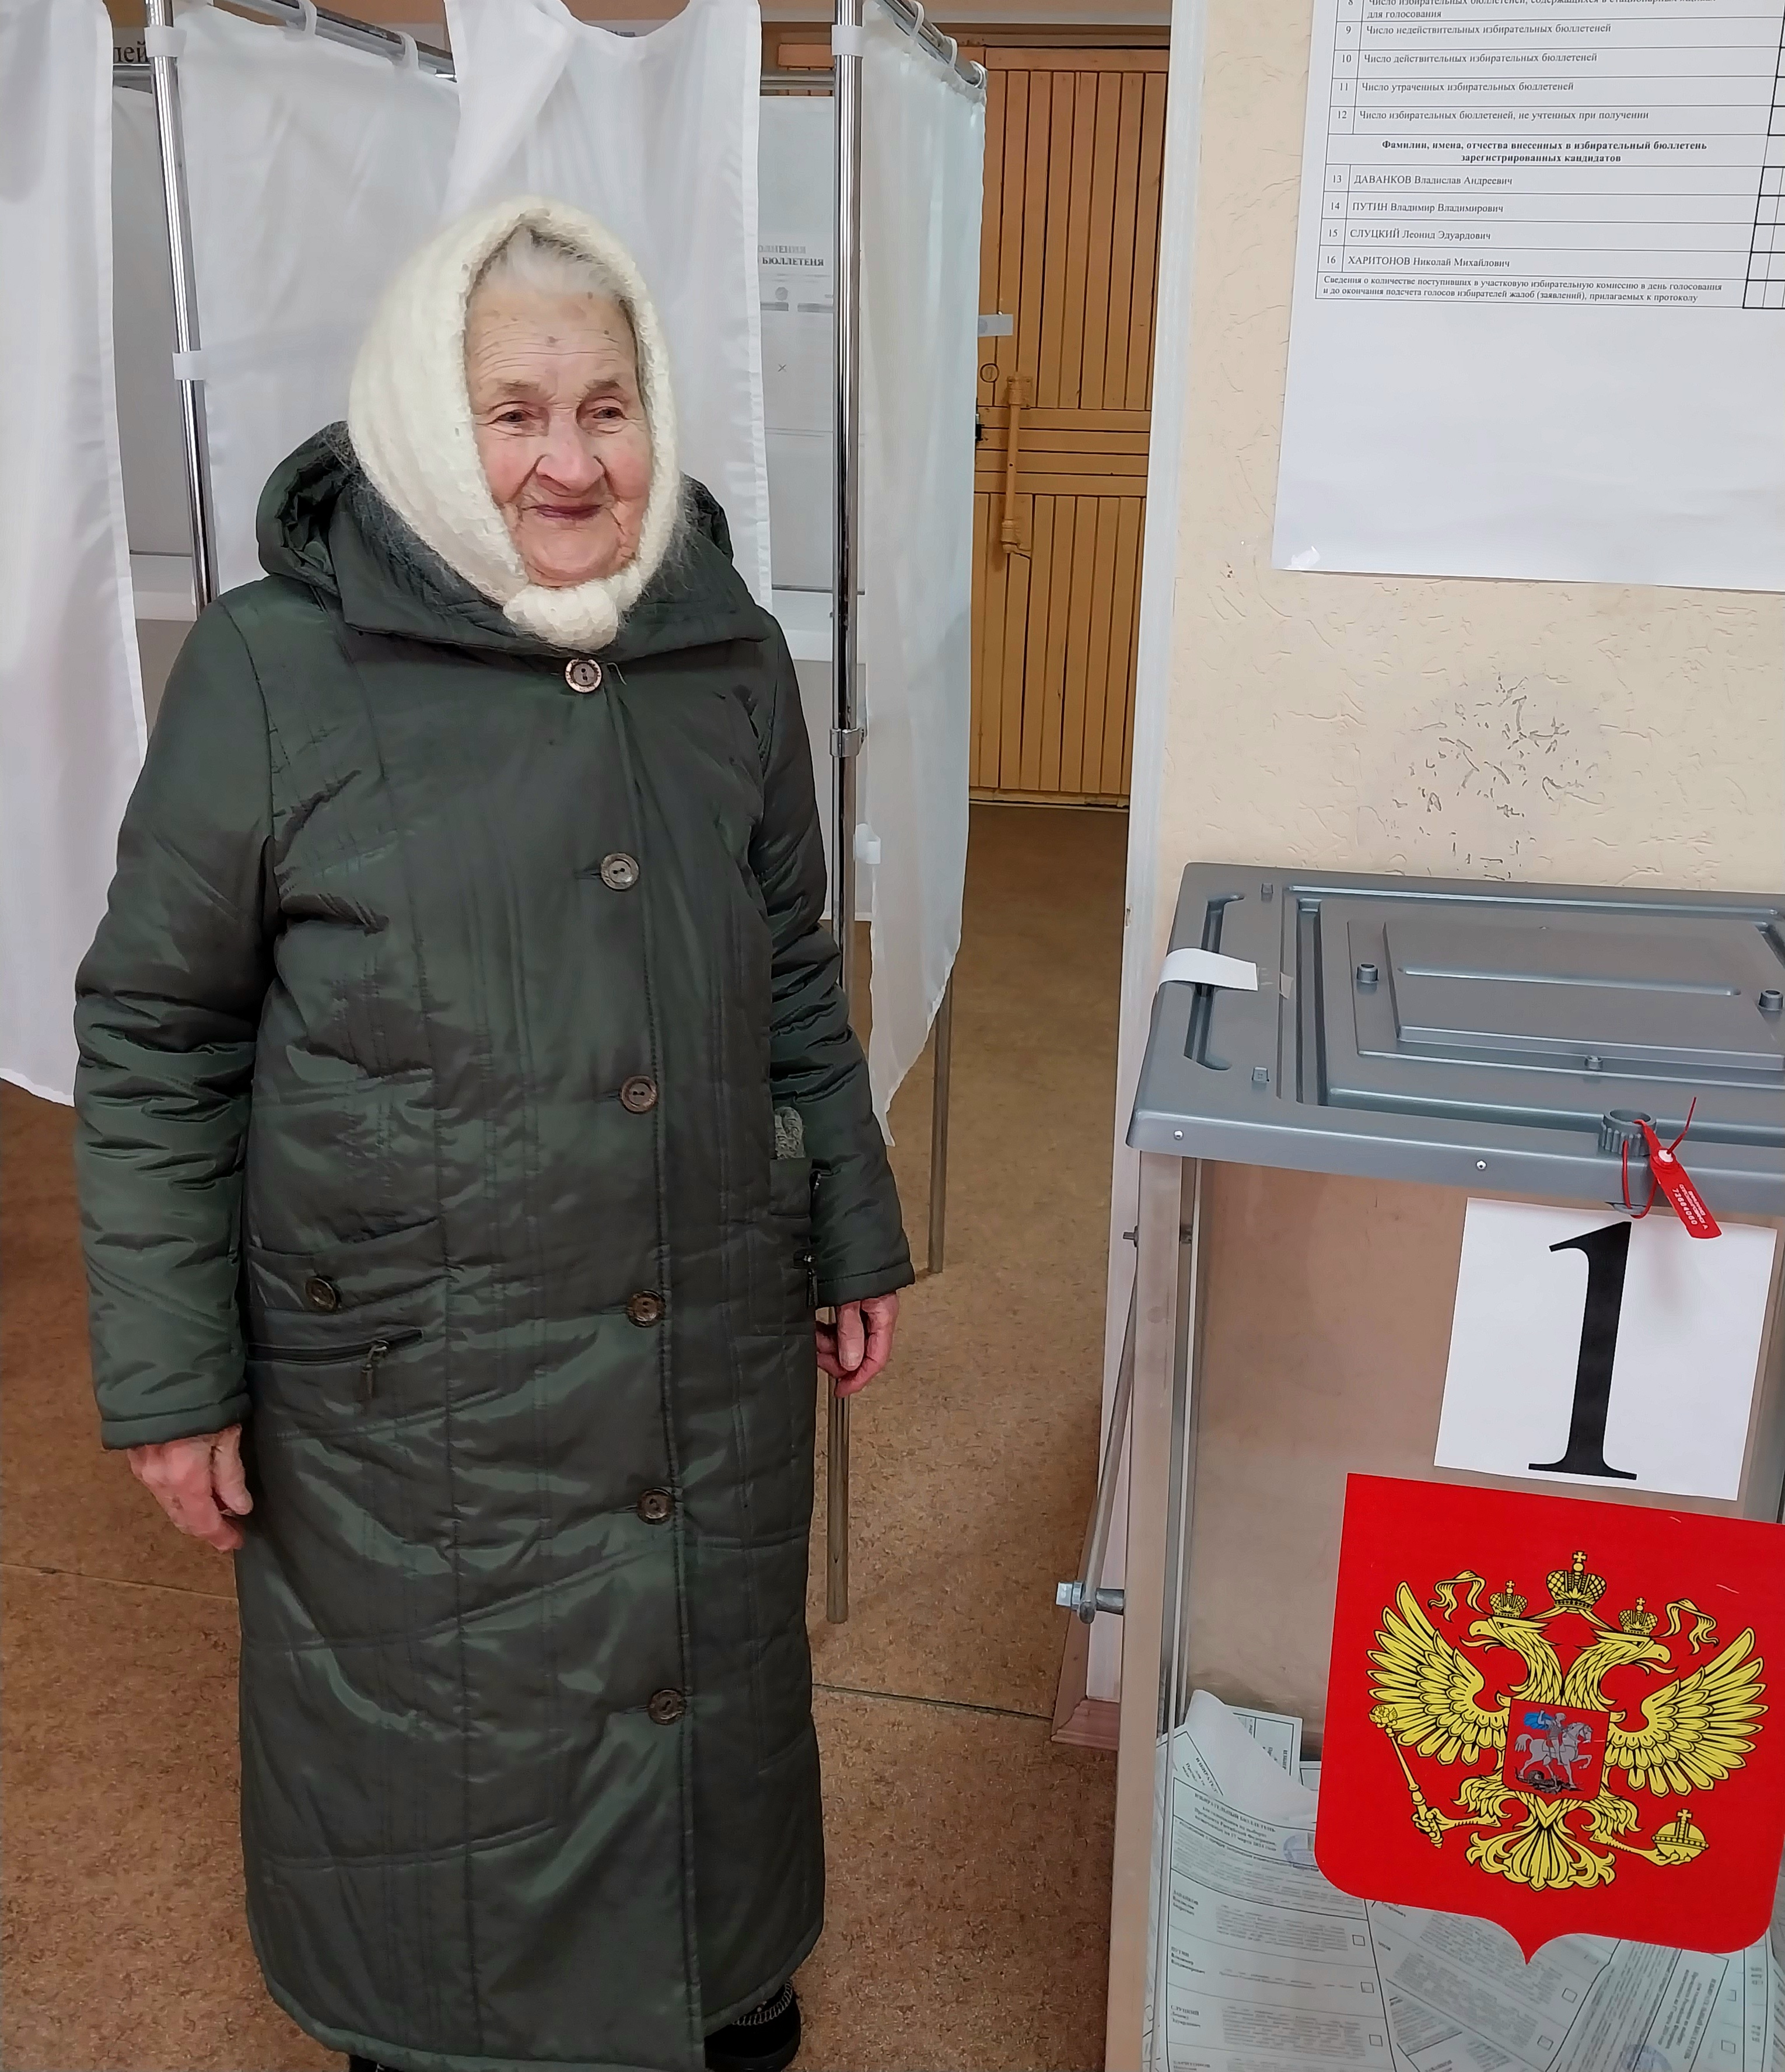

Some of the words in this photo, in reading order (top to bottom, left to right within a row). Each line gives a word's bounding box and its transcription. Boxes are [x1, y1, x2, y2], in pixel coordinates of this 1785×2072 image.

[1346, 25, 1352, 34] 9
[1366, 25, 1394, 34] Число
[1396, 25, 1480, 34] недействительных
[1482, 24, 1553, 36] избирательных
[1555, 23, 1611, 33] бюллетеней
[1342, 54, 1352, 63] 10
[1364, 54, 1392, 63] Число
[1393, 54, 1467, 64] действительных
[1469, 53, 1539, 65] избирательных
[1541, 52, 1597, 62] бюллетеней
[1340, 82, 1348, 91] 11
[1362, 82, 1389, 91] Число
[1391, 85, 1445, 93] утраченных
[1447, 82, 1516, 93] избирательных
[1518, 82, 1574, 91] бюллетеней
[1338, 110, 1347, 119] 12
[1360, 110, 1387, 119] Число
[1389, 110, 1457, 122] избирательных
[1459, 110, 1516, 121] бюллетеней,
[1531, 113, 1576, 121] учтенных
[1578, 113, 1596, 122] при
[1598, 112, 1649, 121] получении
[1382, 140, 1430, 150] Фамилии,
[1432, 142, 1464, 150] имена,
[1574, 141, 1651, 152] избирательный
[1653, 141, 1707, 150] бюллетень
[1461, 155, 1562, 164] зарегистрированных
[1333, 174, 1342, 183] 13
[1353, 174, 1412, 185] ДАВАНКОВ
[1414, 175, 1461, 185] Владислав
[1464, 176, 1513, 187] Андреевич
[1331, 201, 1340, 211] 14
[1352, 202, 1388, 211] ПУТИН
[1390, 202, 1436, 214] Владимир
[1437, 203, 1504, 215] Владимирович
[1329, 229, 1338, 237] 15
[1350, 228, 1400, 239] СЛУЦКИЙ
[1401, 230, 1436, 239] Леонид
[1438, 230, 1491, 242] Эдуардович
[1327, 256, 1336, 264] 16
[1348, 256, 1410, 265] ХАРИТОНОВ
[1413, 257, 1451, 266] Николай
[1454, 258, 1510, 267] Михайлович
[1324, 275, 1362, 284] Сведения
[1418, 279, 1472, 287] поступивших
[1480, 280, 1529, 289] участковую
[1531, 279, 1594, 290] избирательную
[1457, 289, 1507, 299] избирателей
[1509, 290, 1535, 298] жалоб
[1536, 290, 1587, 301] (заявлений),
[1589, 293, 1644, 302] прилагаемых
[1654, 295, 1698, 303] протоколу
[1528, 1221, 1637, 1480] 1
